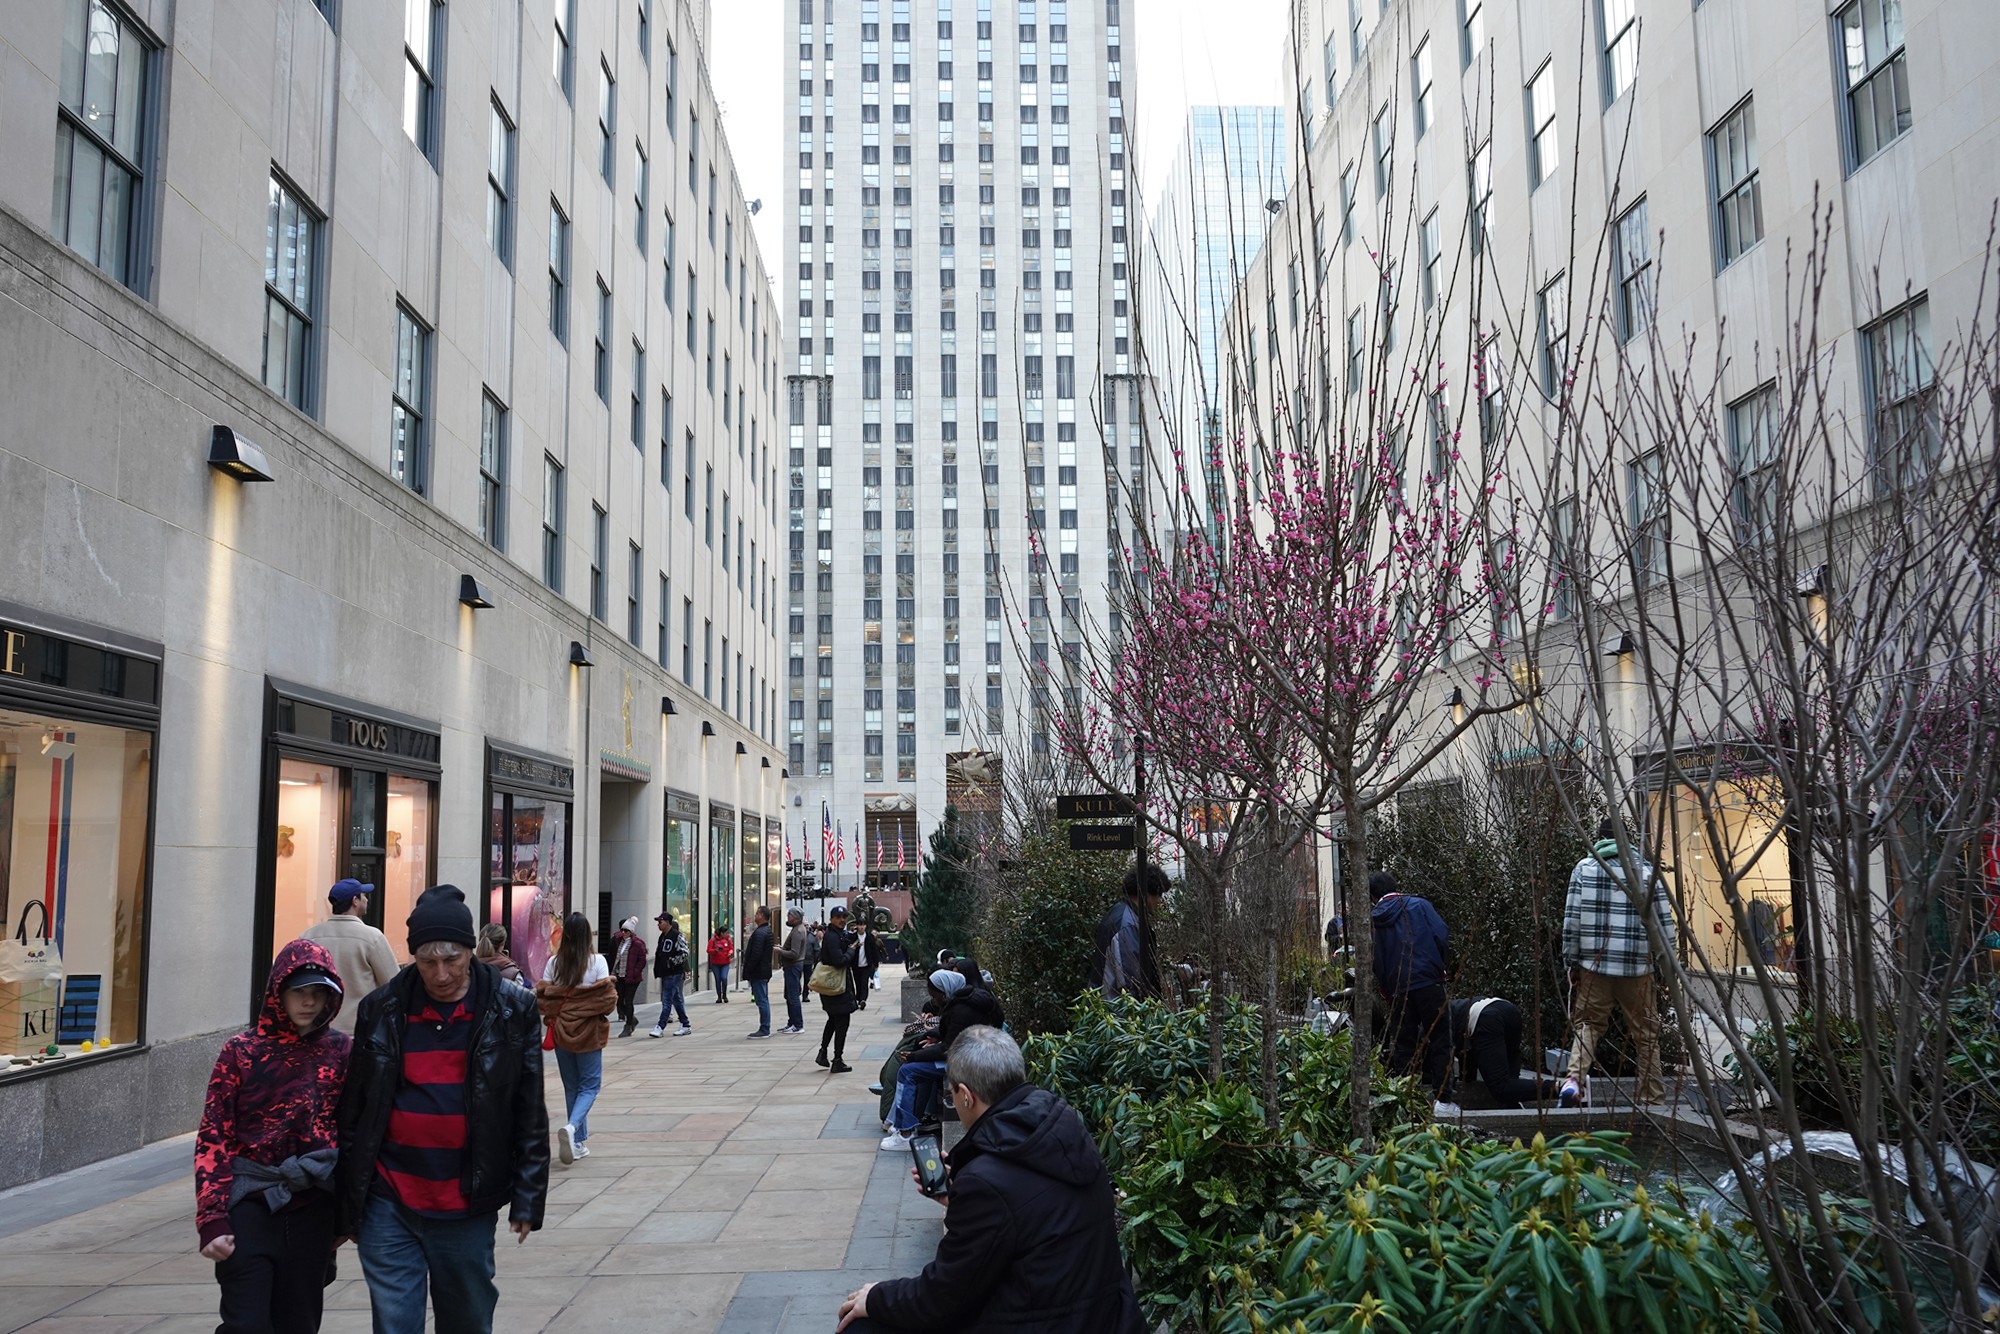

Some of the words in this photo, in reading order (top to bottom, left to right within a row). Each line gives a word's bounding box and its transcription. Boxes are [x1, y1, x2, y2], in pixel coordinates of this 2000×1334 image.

[348, 719, 388, 750] TOUS
[1086, 833, 1101, 841] Rink
[1103, 833, 1120, 842] Level
[662, 938, 673, 953] D
